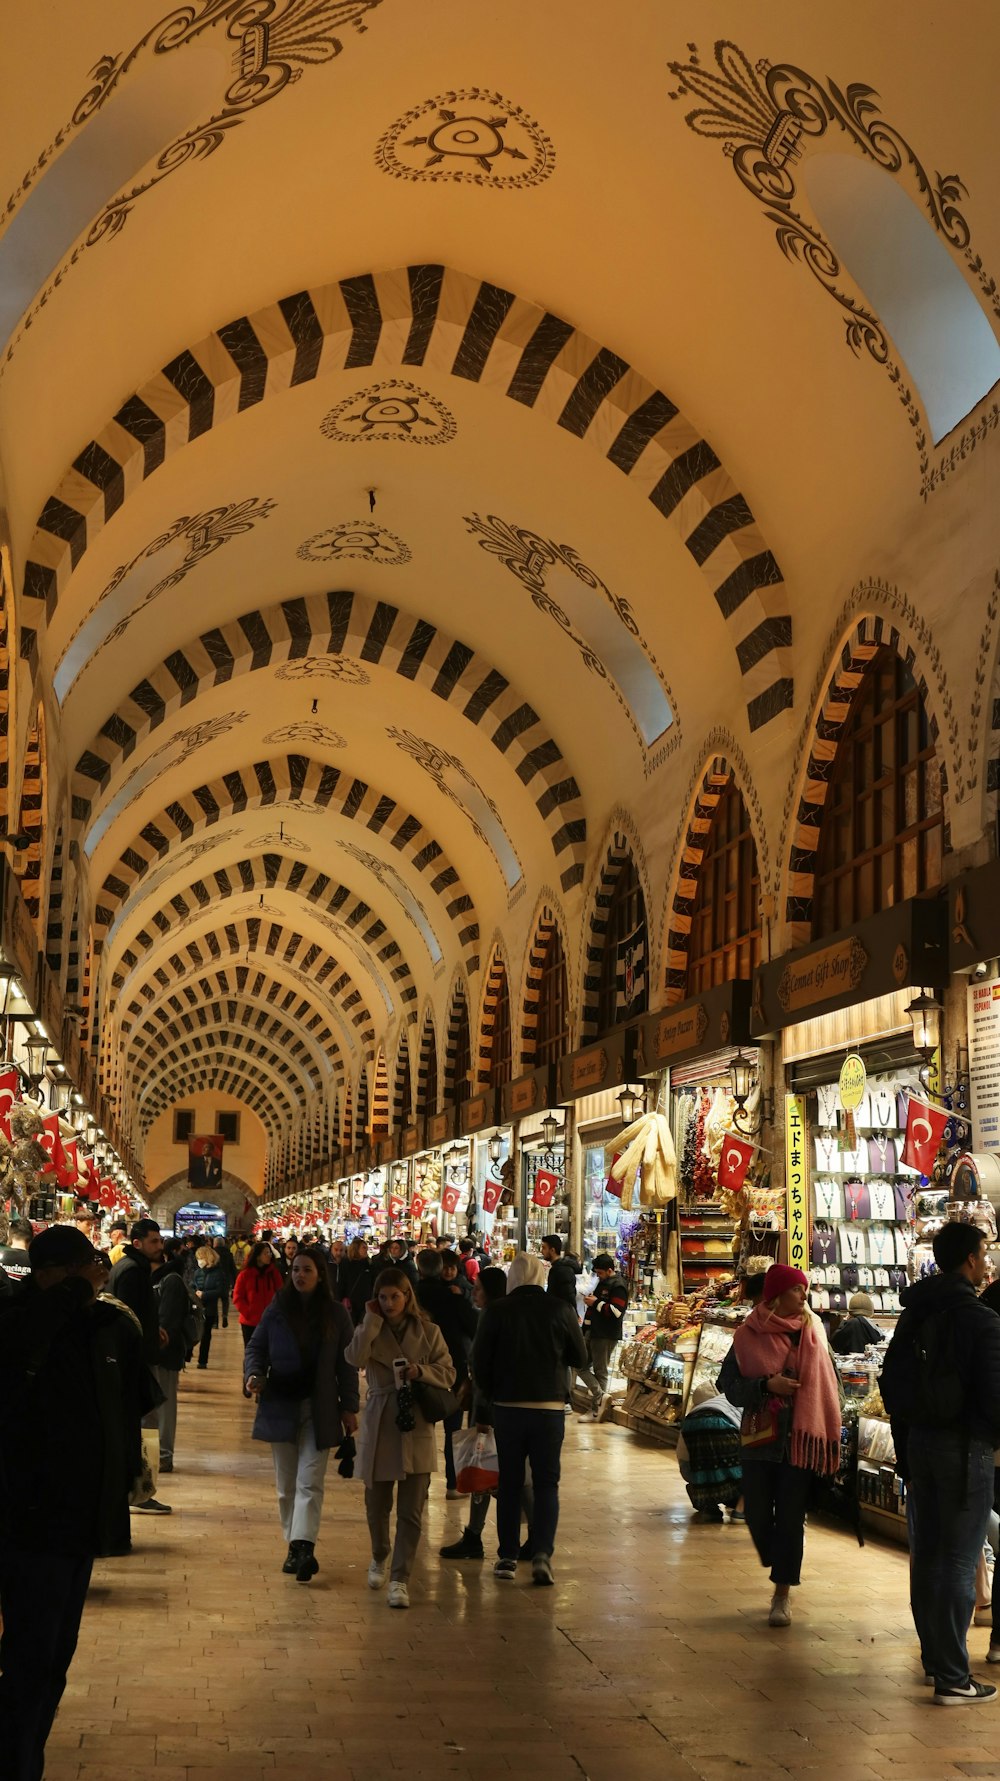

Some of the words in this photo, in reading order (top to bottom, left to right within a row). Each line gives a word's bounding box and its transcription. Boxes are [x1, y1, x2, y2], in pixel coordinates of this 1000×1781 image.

[790, 970, 813, 993] Cennet
[815, 963, 829, 988] Gift
[831, 954, 849, 981] Shop
[973, 990, 978, 999] SE
